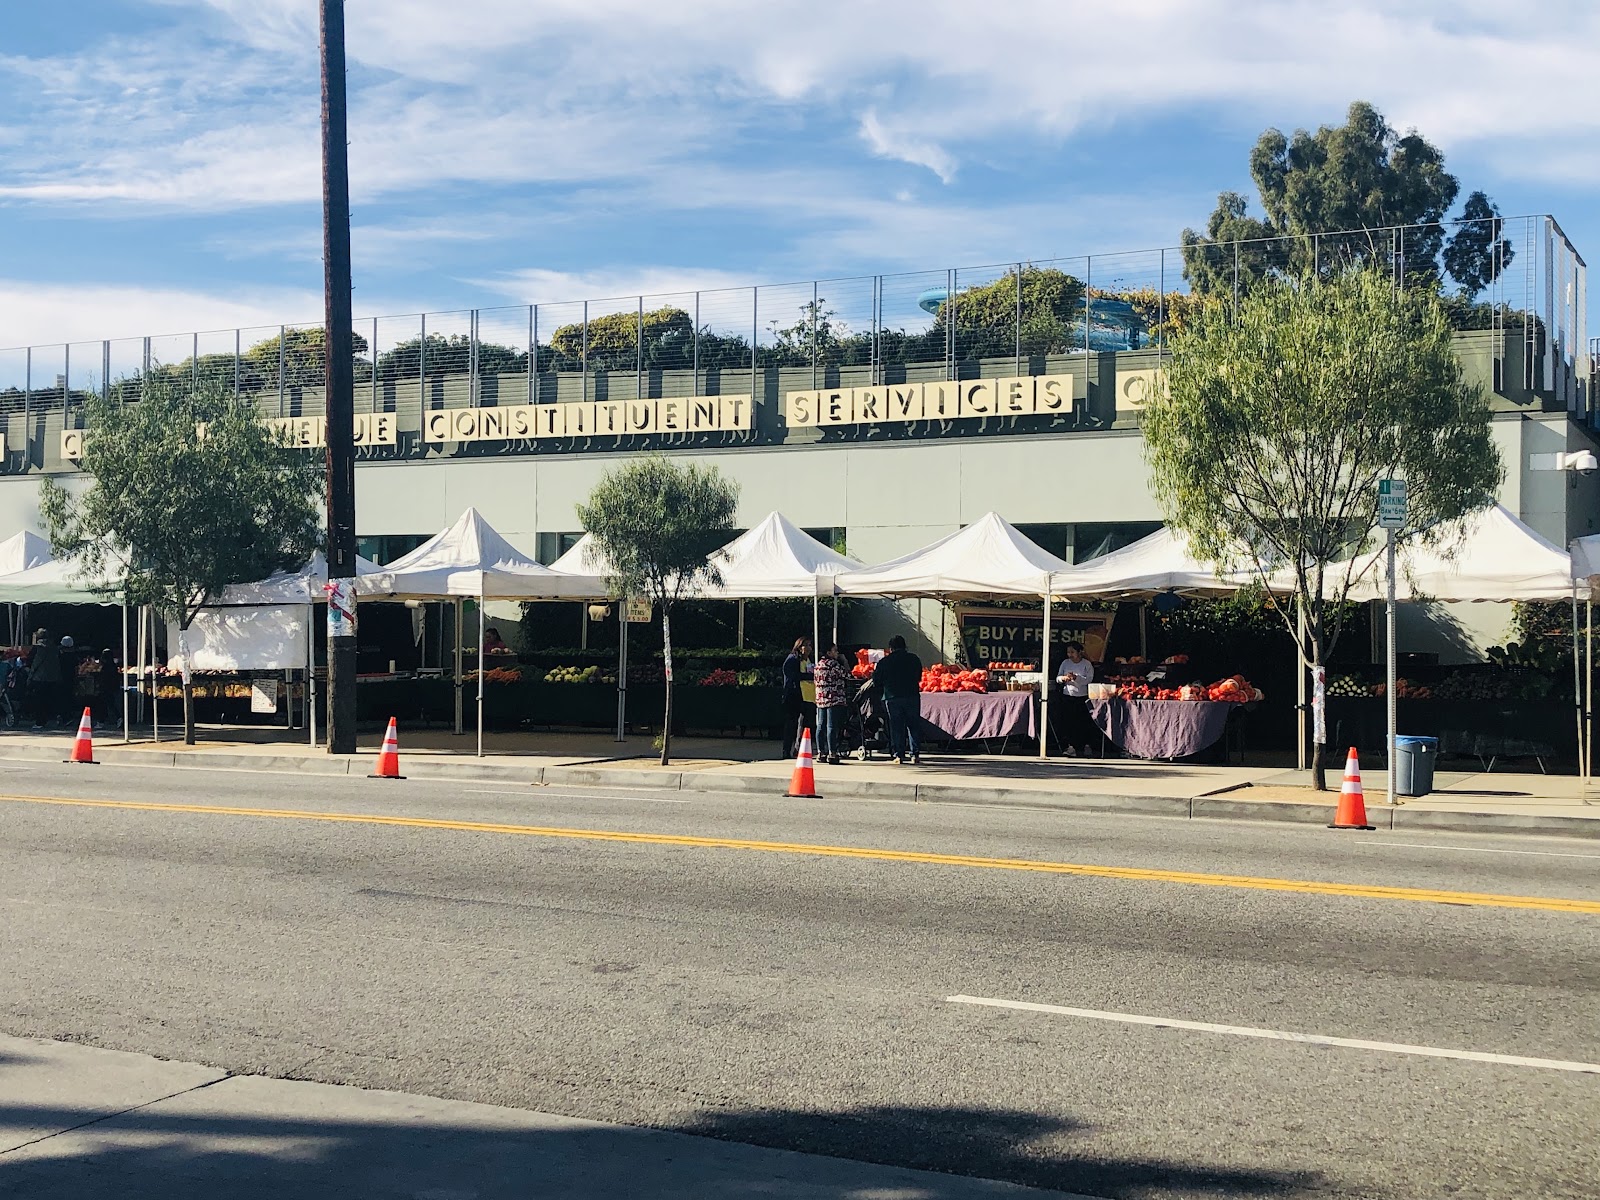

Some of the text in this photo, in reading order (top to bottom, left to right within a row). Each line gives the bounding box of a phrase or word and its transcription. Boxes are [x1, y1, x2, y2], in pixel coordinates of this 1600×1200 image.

[429, 398, 745, 439] CONSTITUENT
[792, 379, 1062, 424] SERVICES
[1381, 496, 1405, 505] PARKING
[979, 625, 1086, 643] BUY FRESH
[979, 645, 1014, 660] BUY
